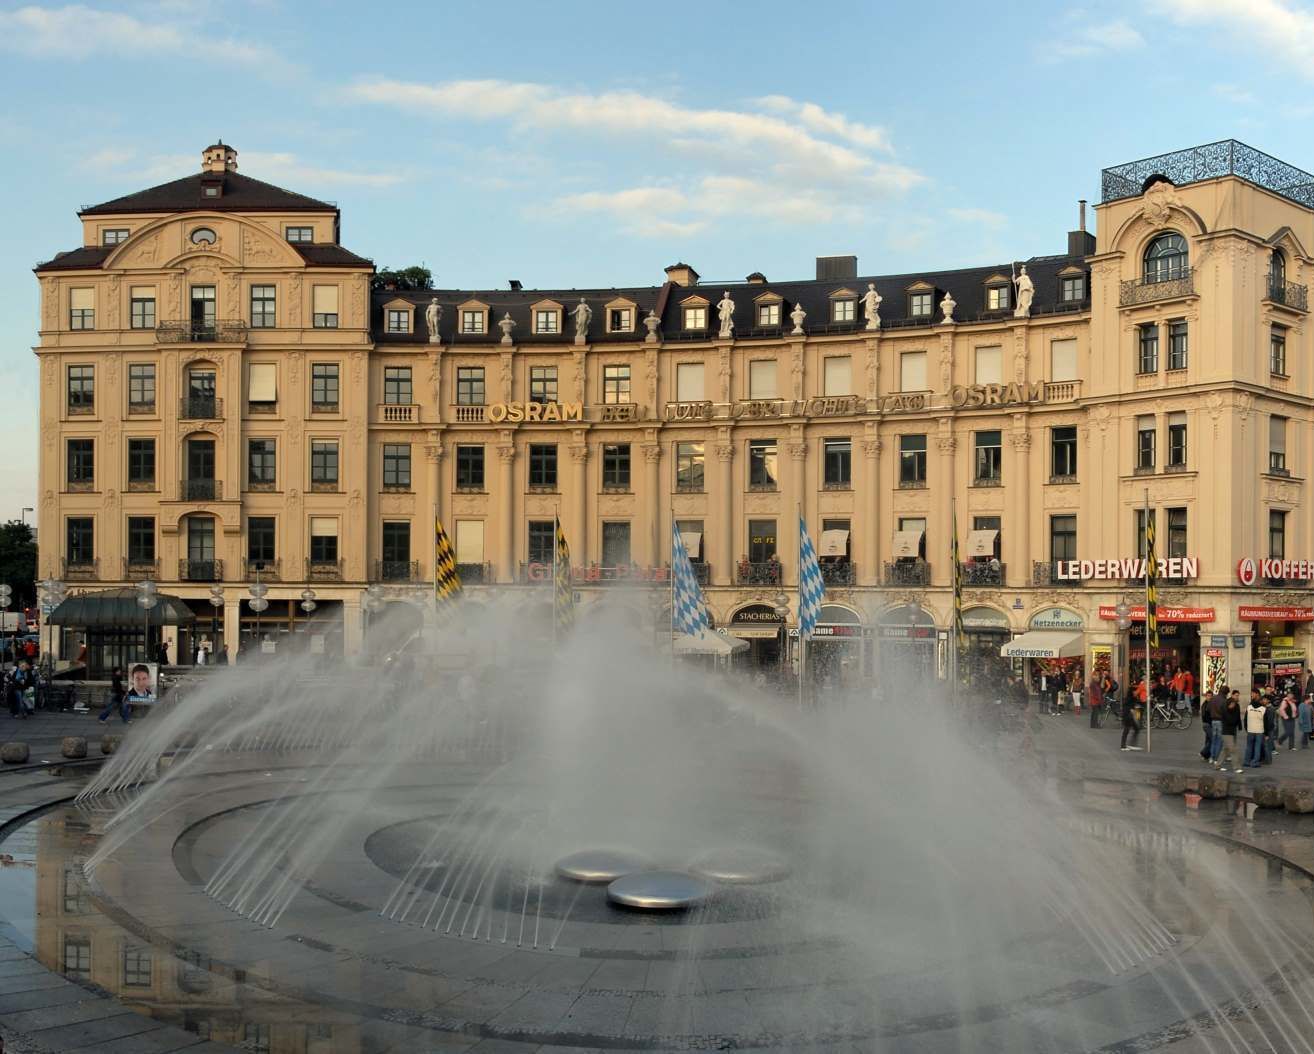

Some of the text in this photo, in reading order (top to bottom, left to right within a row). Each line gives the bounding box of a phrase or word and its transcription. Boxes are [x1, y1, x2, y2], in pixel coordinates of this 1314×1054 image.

[487, 401, 583, 422] OSRAM
[951, 380, 1045, 407] OSRAM
[1167, 610, 1184, 618] 70%
[1007, 648, 1053, 656] Lederwaren
